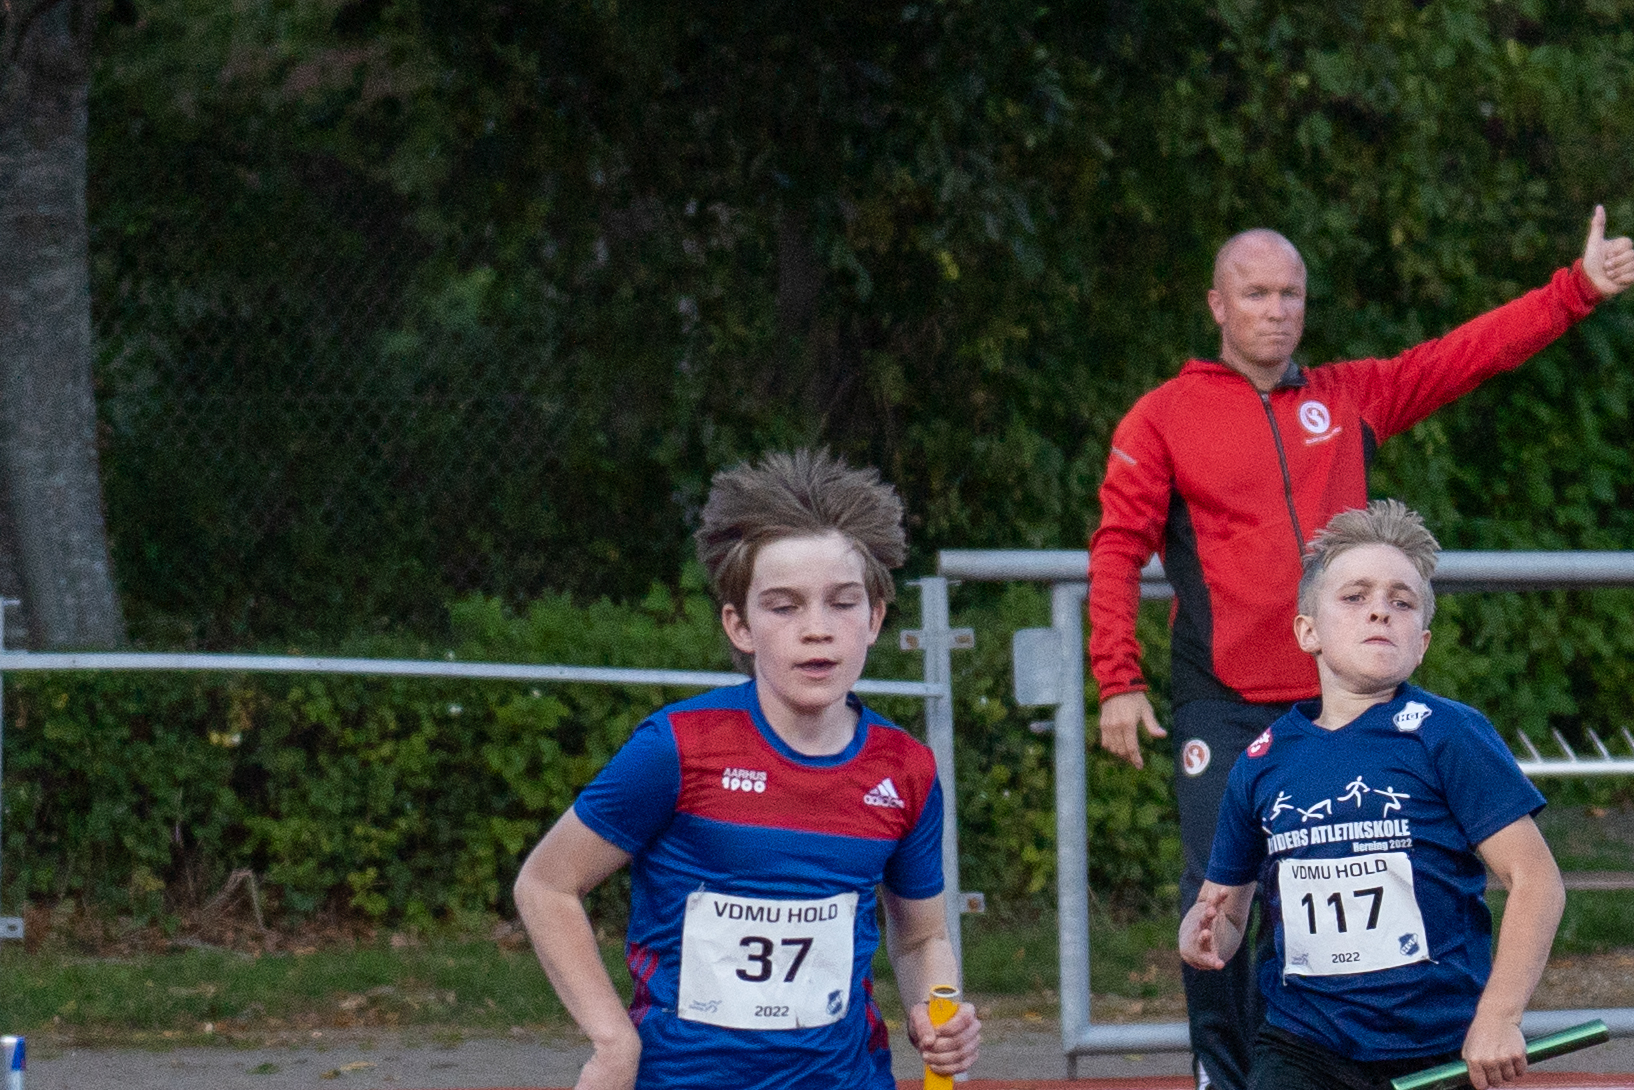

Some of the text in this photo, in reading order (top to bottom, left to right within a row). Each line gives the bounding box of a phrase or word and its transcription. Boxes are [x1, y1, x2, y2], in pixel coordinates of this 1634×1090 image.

[722, 776, 766, 793] 1900
[1311, 819, 1411, 845] ATLETIKSKOLE
[1389, 838, 1413, 849] 2022
[1292, 859, 1388, 880] VDMU HOLD
[714, 901, 839, 923] VDMU HOLD
[1301, 886, 1384, 935] 117
[736, 936, 814, 983] 37
[1331, 952, 1361, 964] 2022
[755, 1005, 790, 1018] 2022
